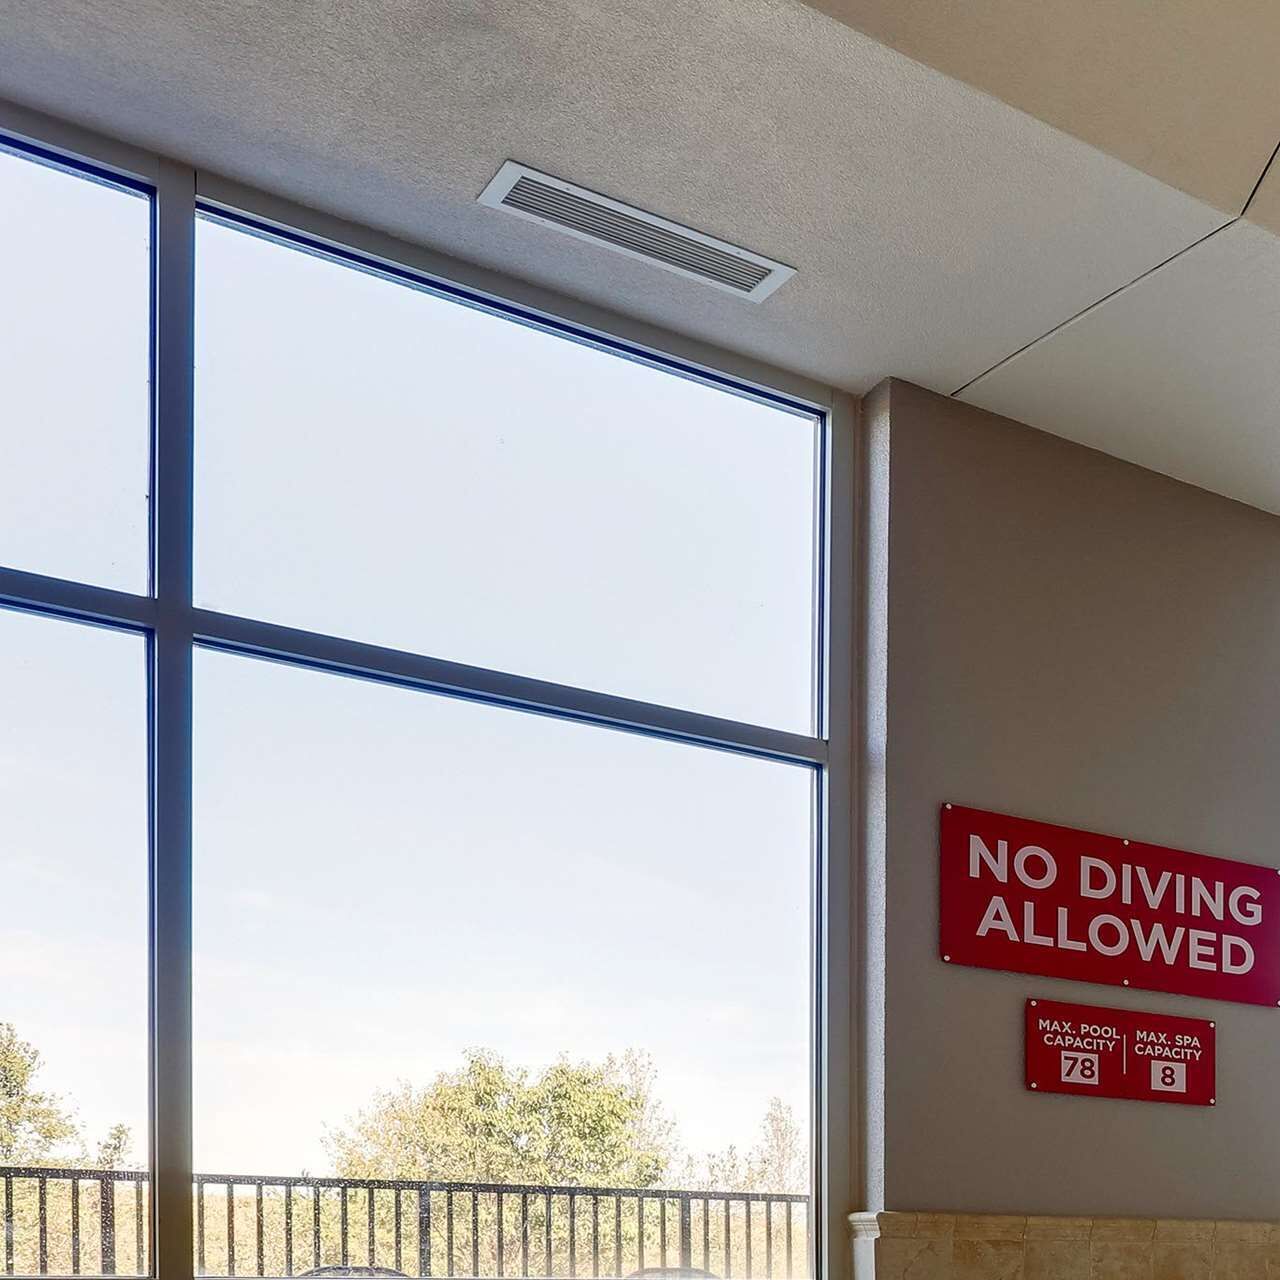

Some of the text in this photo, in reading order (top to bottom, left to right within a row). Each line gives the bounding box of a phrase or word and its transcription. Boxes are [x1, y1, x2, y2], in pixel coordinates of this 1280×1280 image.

[969, 834, 1263, 926] NO DIVING
[975, 895, 1256, 975] ALLOWED
[1038, 1018, 1120, 1039] MAX. POOL
[1136, 1030, 1201, 1048] MAX. SPA
[1043, 1034, 1116, 1052] CAPACITY
[1134, 1043, 1202, 1061] CAPACITY
[1063, 1055, 1096, 1080] 78
[1160, 1065, 1176, 1087] 8
